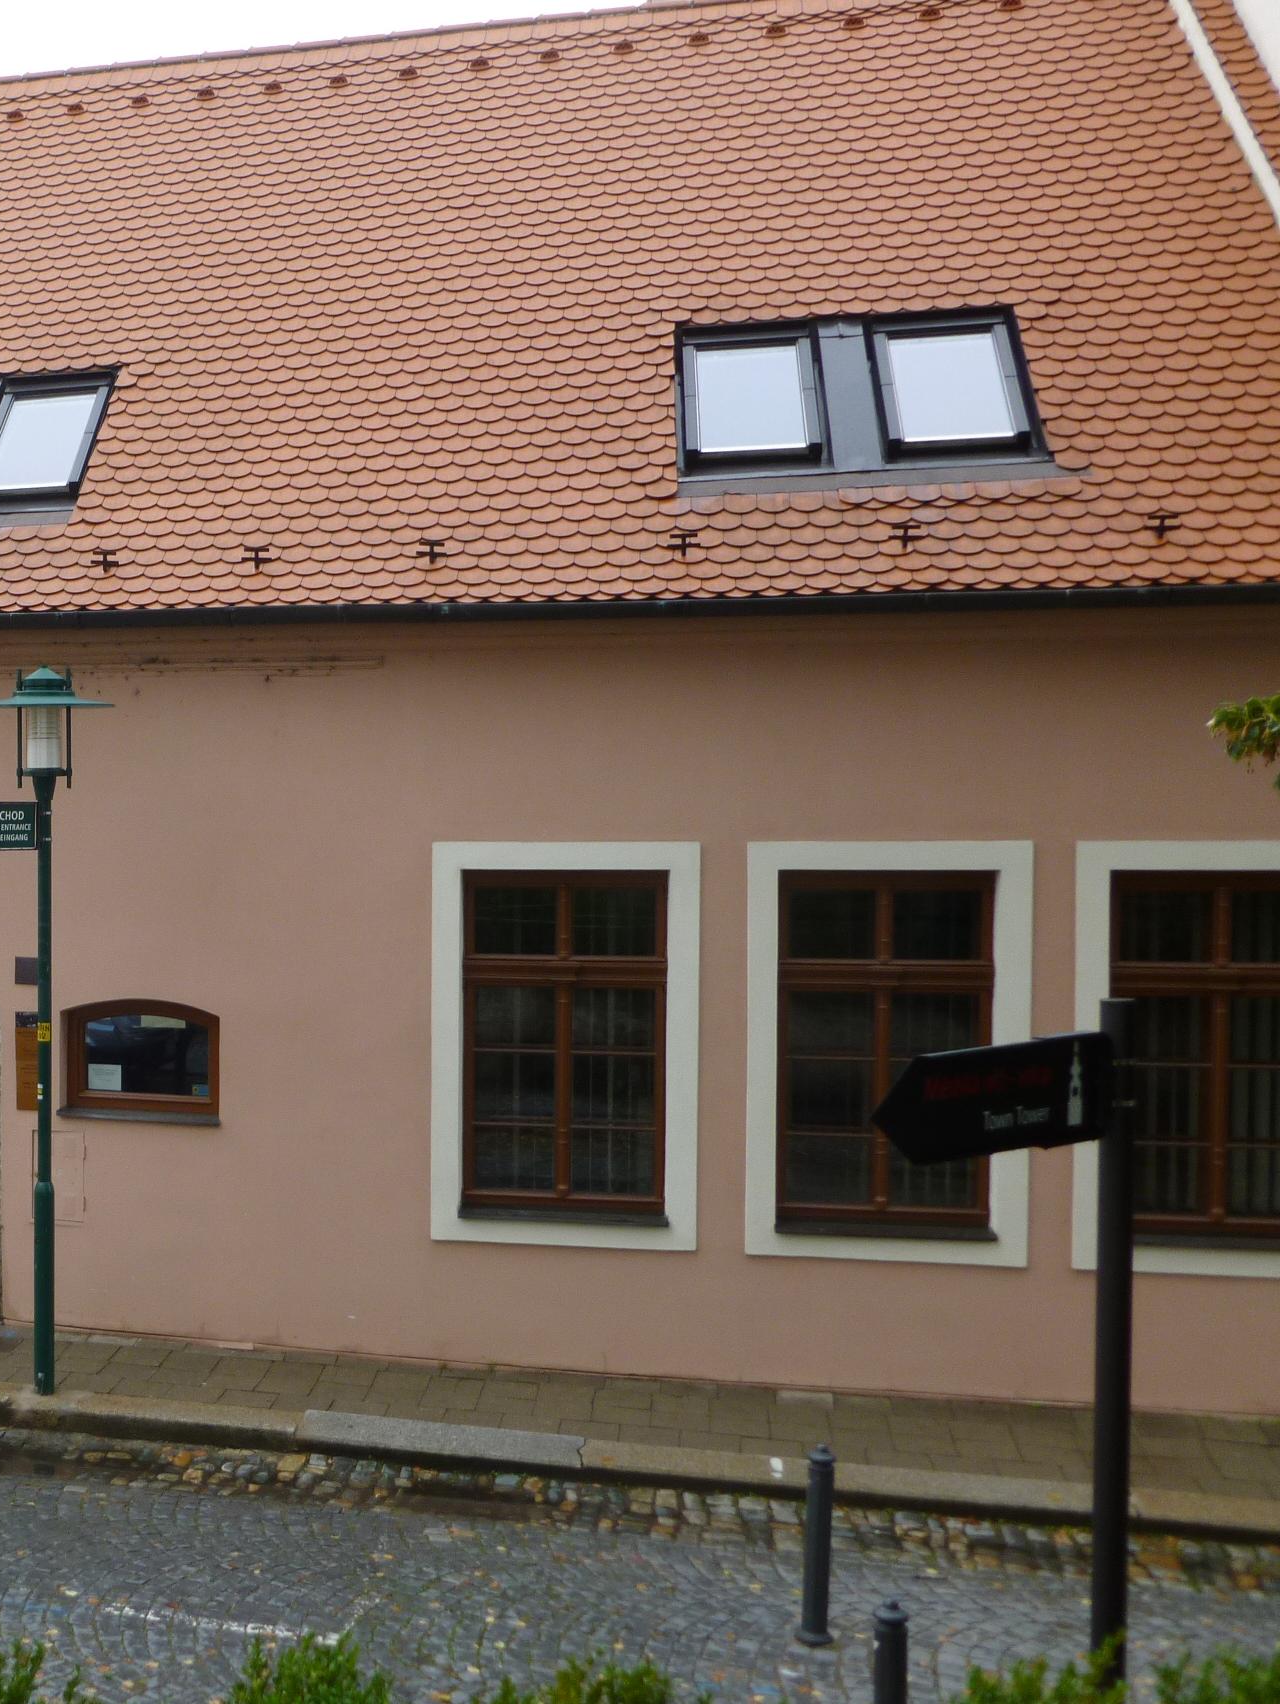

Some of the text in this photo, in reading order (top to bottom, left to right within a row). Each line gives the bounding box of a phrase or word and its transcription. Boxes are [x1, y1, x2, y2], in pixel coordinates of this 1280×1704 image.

[1, 823, 31, 831] ENTRANCE
[983, 1105, 1051, 1130] Town Tower
